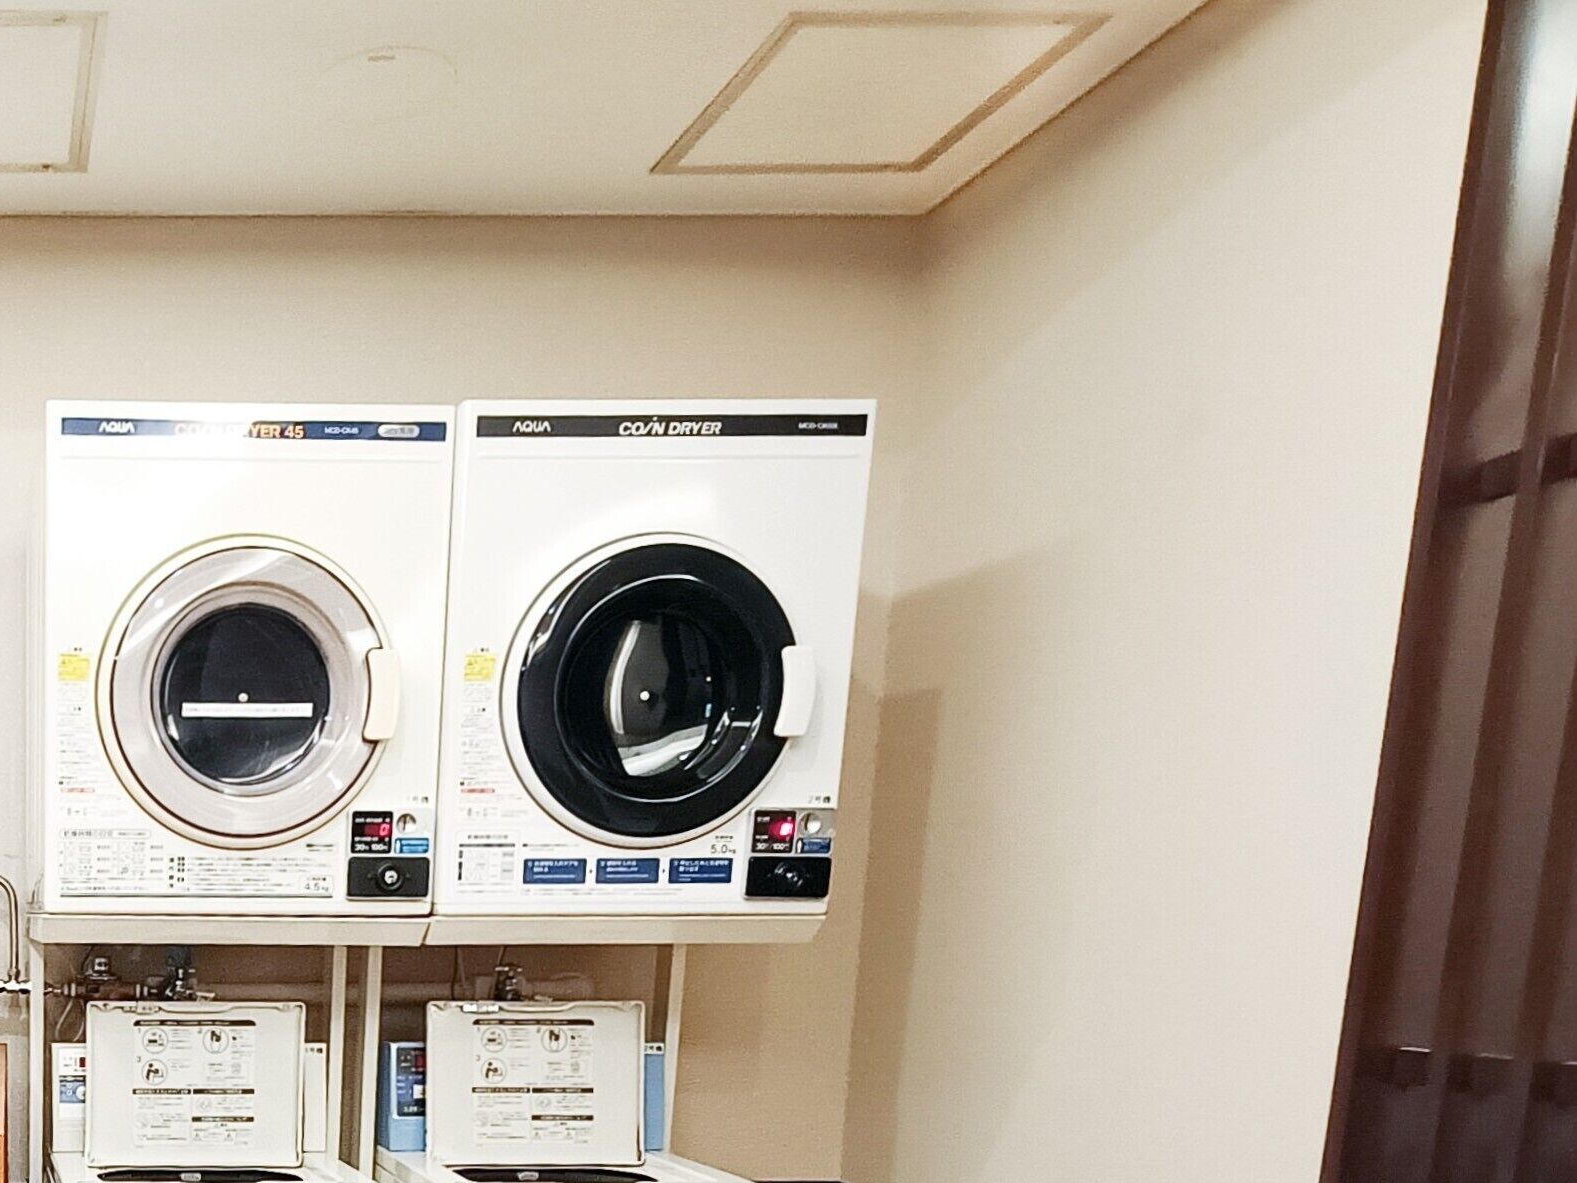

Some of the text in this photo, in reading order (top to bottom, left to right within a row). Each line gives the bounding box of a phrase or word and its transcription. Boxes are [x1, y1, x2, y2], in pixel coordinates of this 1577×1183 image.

[98, 421, 136, 434] AQUA
[284, 424, 304, 439] 45
[512, 421, 552, 433] AQUA
[618, 416, 722, 436] COIN DRYER
